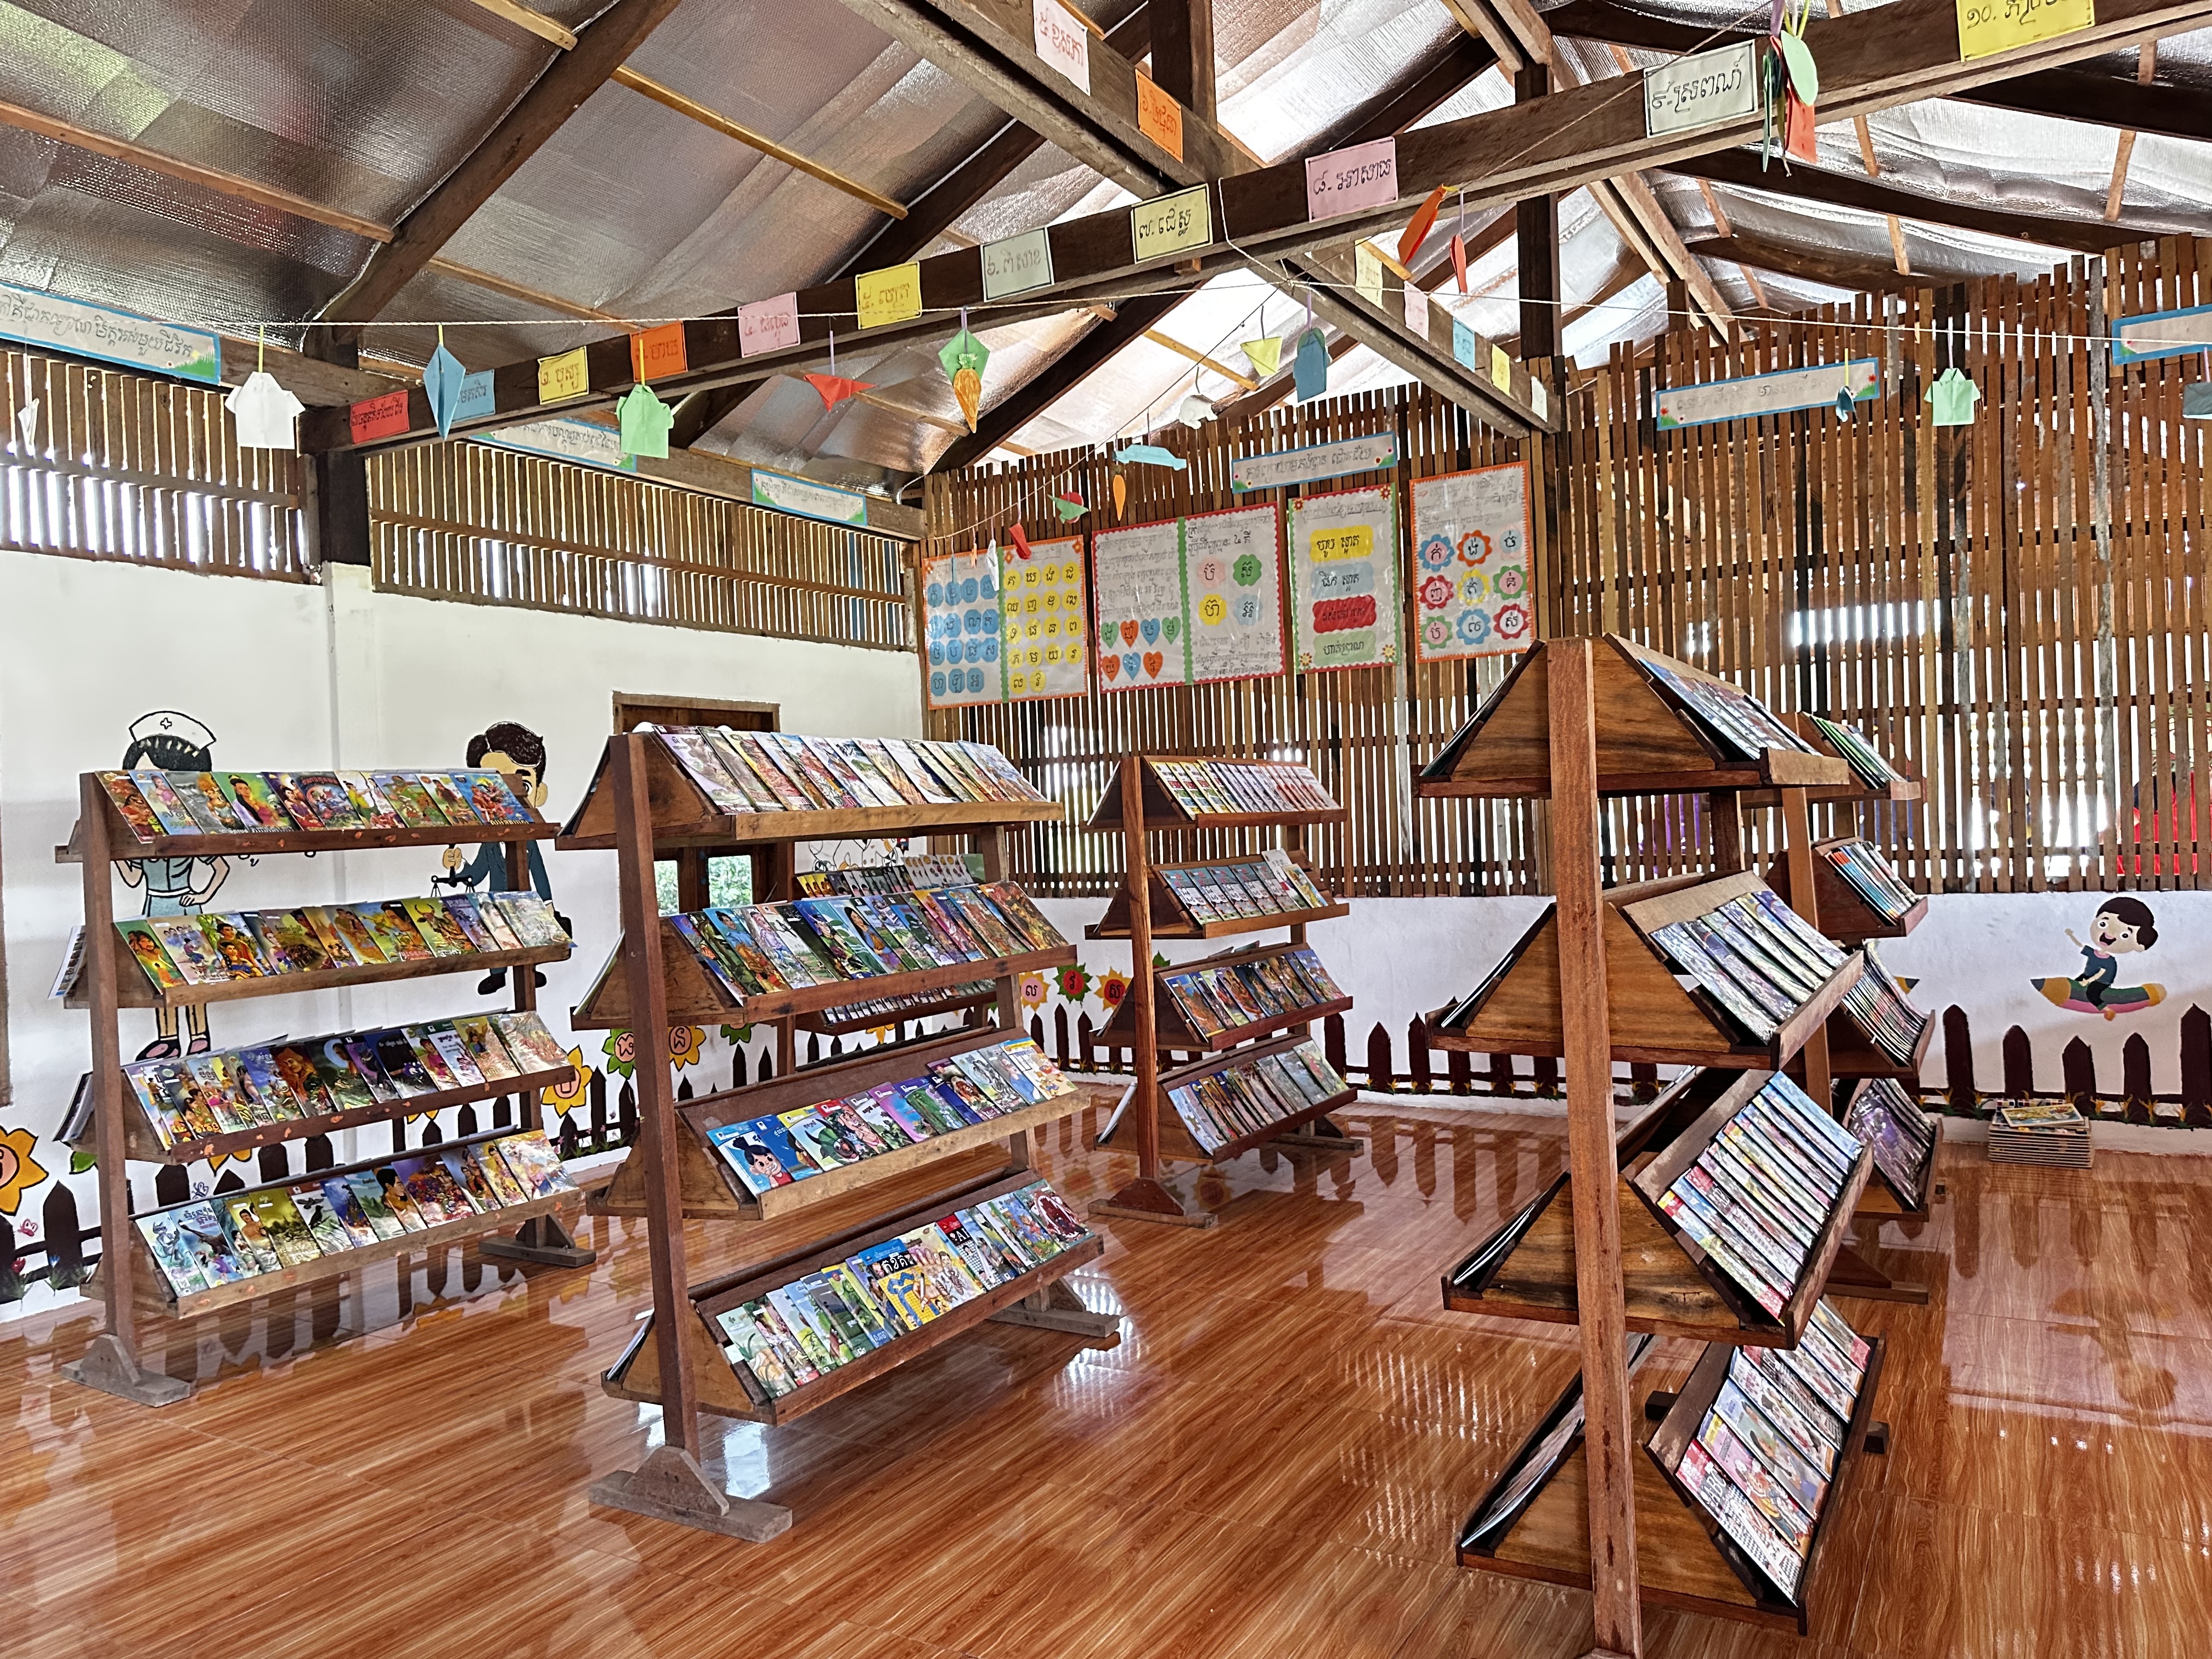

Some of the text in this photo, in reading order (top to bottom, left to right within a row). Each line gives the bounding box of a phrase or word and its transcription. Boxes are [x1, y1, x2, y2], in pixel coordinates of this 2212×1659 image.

[1431, 543, 1442, 561] ក់
[1046, 567, 1055, 582] ង
[1027, 599, 1037, 613] ញ
[1048, 623, 1057, 633] ន
[1069, 621, 1077, 631] ព
[950, 646, 958, 657] ប
[986, 645, 995, 655] ស
[1029, 652, 1039, 663] ម
[1048, 650, 1059, 660] យ
[933, 678, 944, 690] ហ
[970, 675, 980, 687] អ
[1013, 678, 1024, 689] ល
[1025, 985, 1038, 996] ល
[1109, 983, 1122, 999] ស
